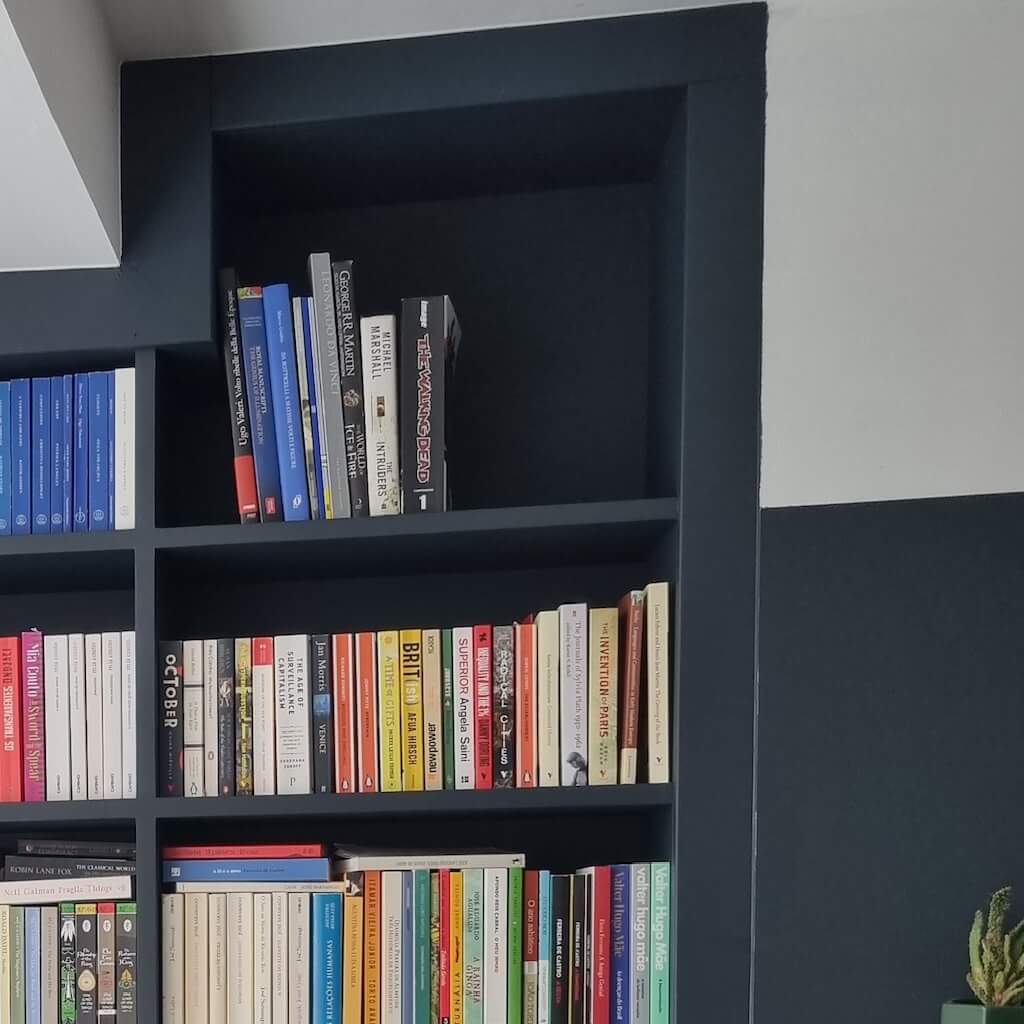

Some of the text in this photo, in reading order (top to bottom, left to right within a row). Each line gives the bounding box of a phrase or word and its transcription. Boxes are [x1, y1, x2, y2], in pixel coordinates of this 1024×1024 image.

[340, 270, 355, 376] GEORGE MARTIN
[371, 326, 381, 380] MARSHALL
[383, 331, 391, 372] MICHAEL
[417, 335, 431, 483] THE WALKING DEAD
[345, 424, 357, 478] ICE FIRE
[356, 433, 365, 468] WORLD
[376, 442, 387, 496] INTRUDERS
[316, 641, 326, 656] Jan
[318, 660, 327, 691] Morris
[600, 637, 609, 695] INVENTION
[163, 654, 178, 728] OCTOBER
[298, 698, 303, 707] OF
[458, 638, 470, 762] SUPERIOR Angela Saini
[408, 713, 417, 765] AFUA HIRSCH
[600, 706, 609, 737] PARIS
[634, 867, 648, 971] valter hugo mãe
[652, 867, 667, 970] Valter Hugo Mãe
